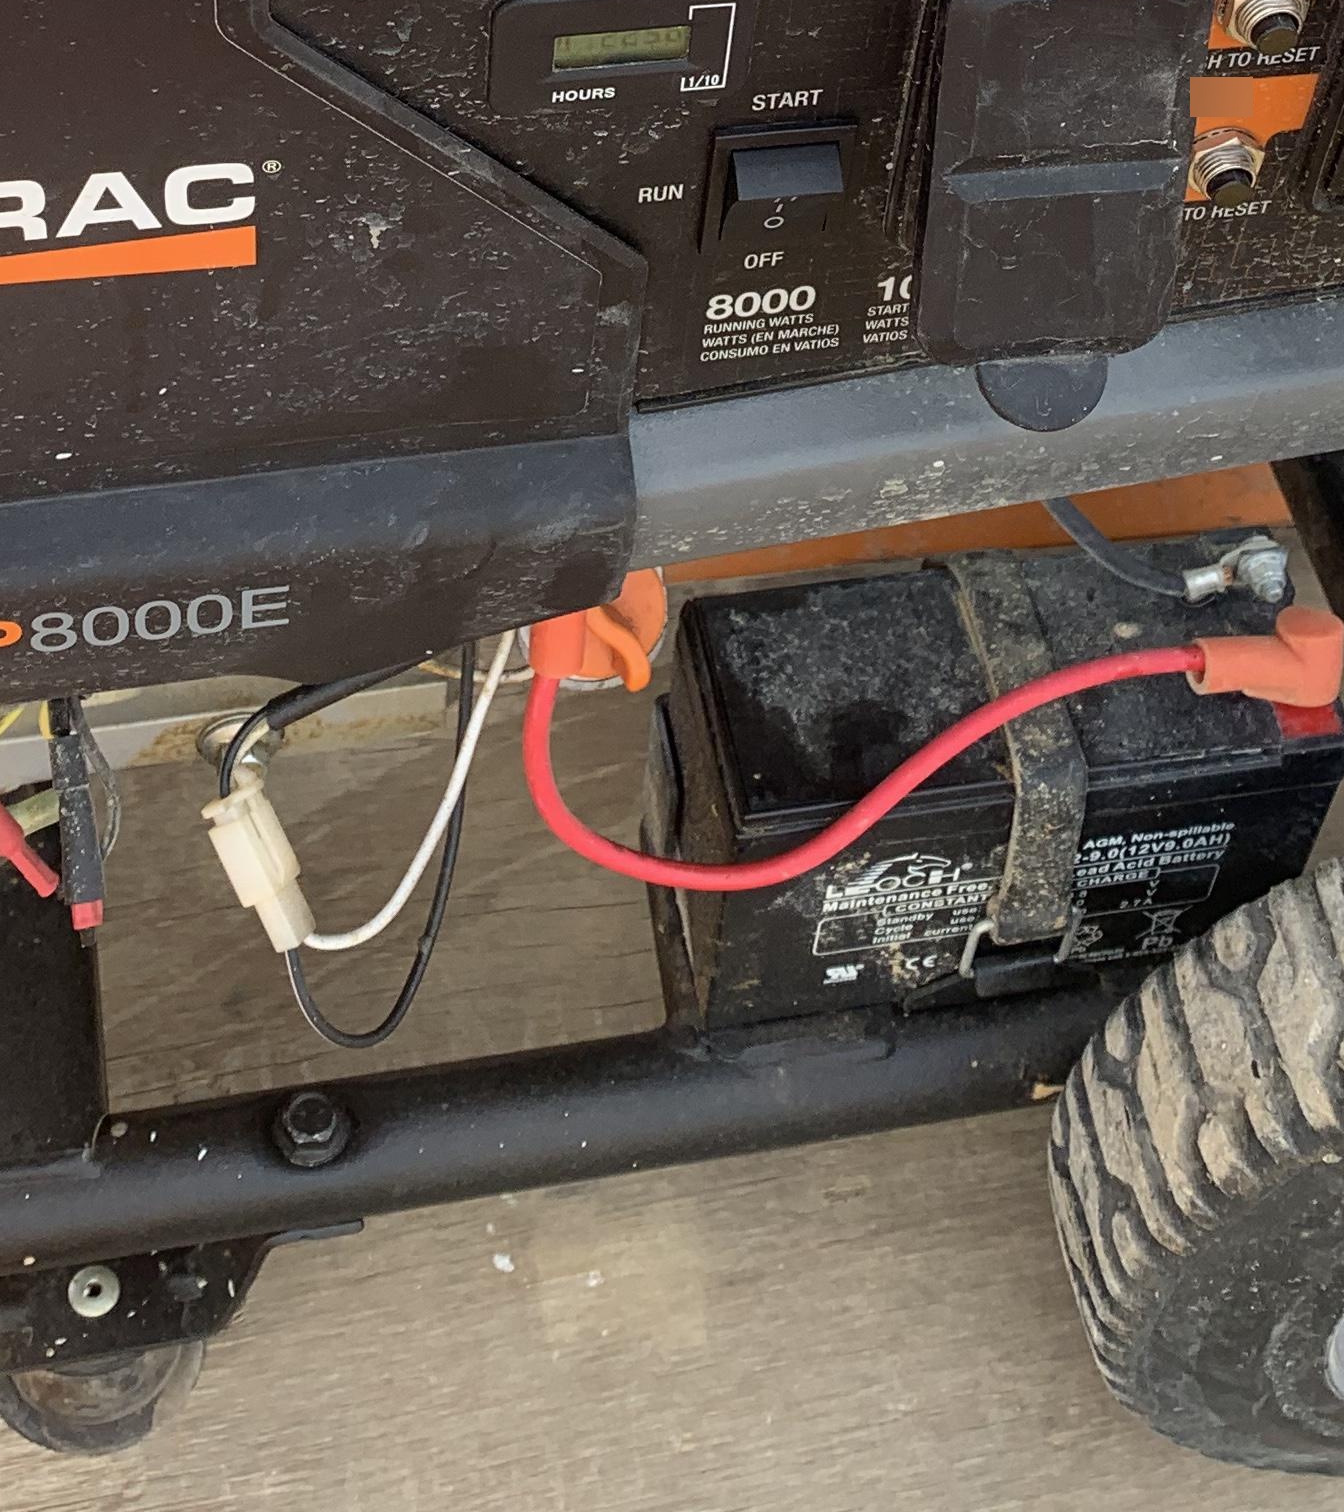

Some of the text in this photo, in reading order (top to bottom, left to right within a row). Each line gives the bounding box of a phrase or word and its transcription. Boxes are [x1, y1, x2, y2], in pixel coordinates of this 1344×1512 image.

[1227, 51, 1252, 68] TO
[688, 74, 720, 88] 1/10
[551, 87, 616, 103] HOURS
[751, 90, 824, 111] START
[637, 184, 685, 203] RUN
[1184, 207, 1206, 222] TO
[743, 251, 785, 270] OFF
[706, 286, 817, 321] 8000
[703, 313, 814, 335] RUNNING WATTS
[865, 316, 910, 331] WATTS
[702, 324, 839, 348] WATTS (EN MARCHE)
[862, 329, 908, 344] VATIOS
[700, 337, 840, 362] CONSUMO EN VATIOS
[1082, 821, 1236, 851] AGM, Non-spillable
[822, 886, 943, 913] Maintenance
[1072, 862, 1110, 877] ead
[1112, 856, 1155, 872] Acid
[1158, 849, 1226, 866] Battery
[895, 869, 1149, 913] CONSTANT CHARGE
[876, 911, 935, 927] Standby
[872, 931, 911, 945] Initial
[874, 923, 914, 936] Cycle
